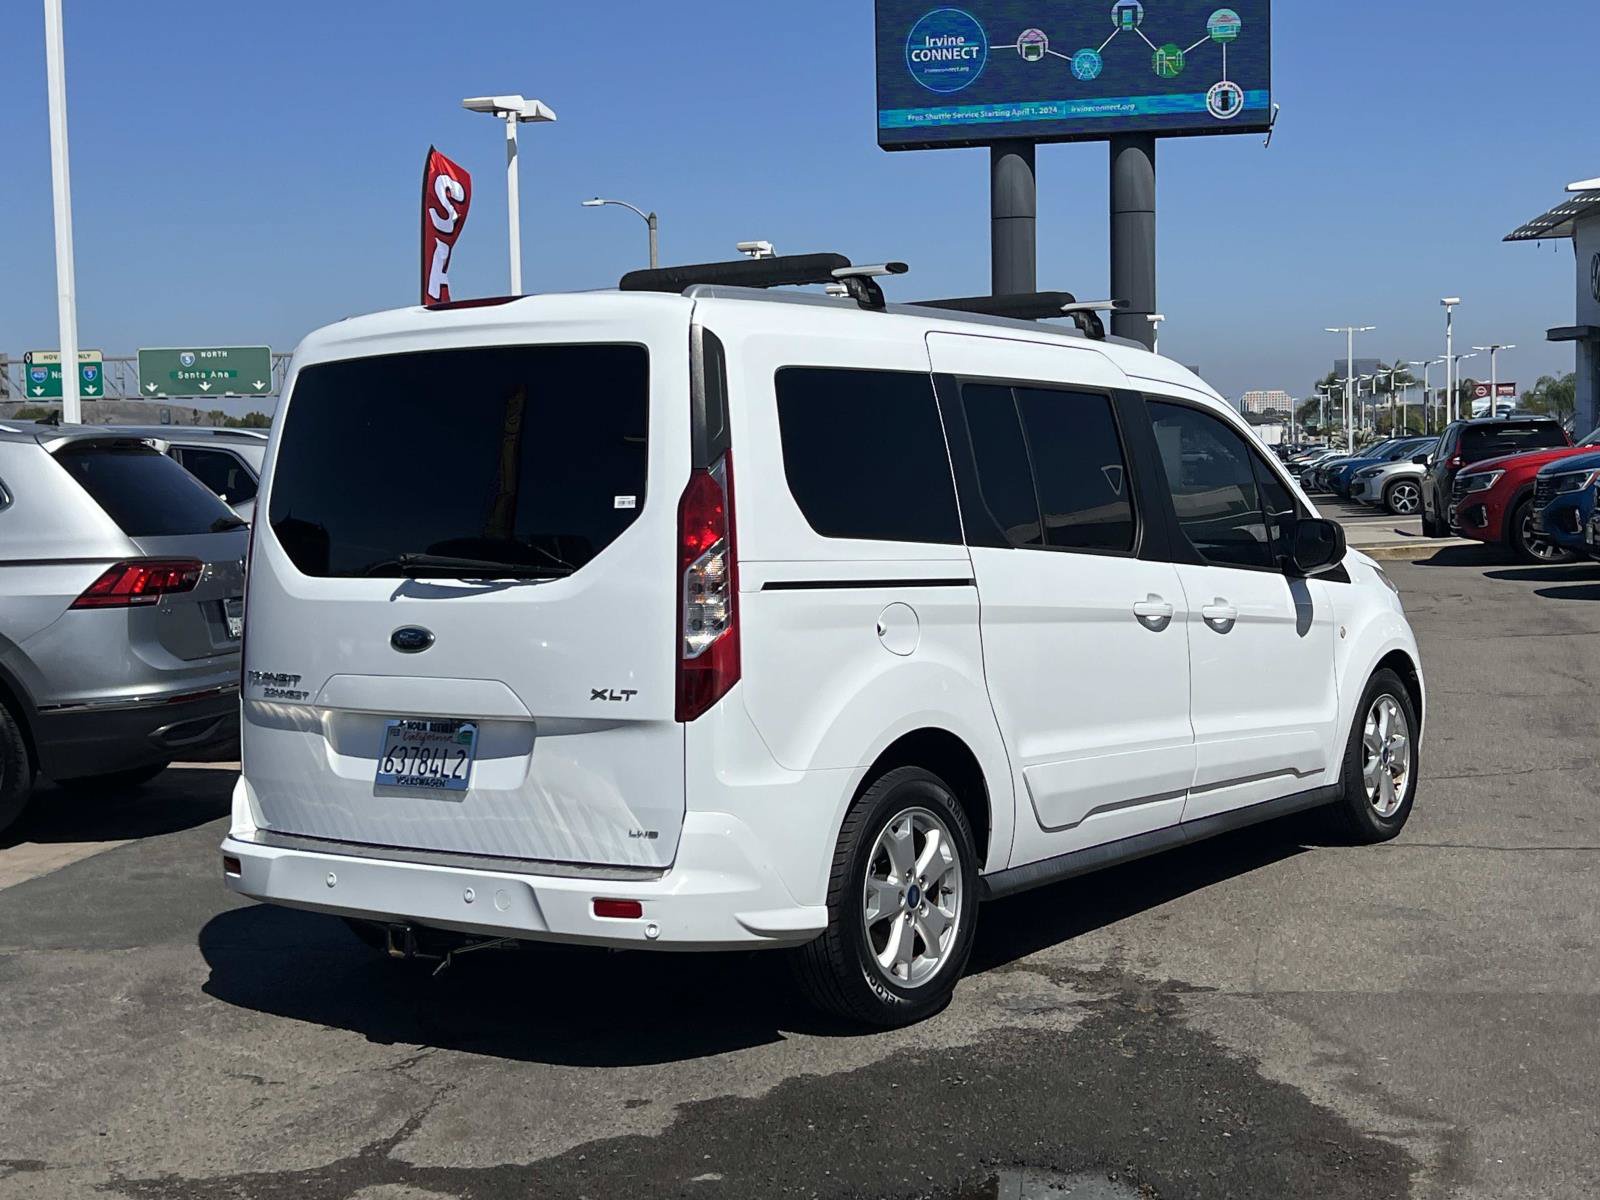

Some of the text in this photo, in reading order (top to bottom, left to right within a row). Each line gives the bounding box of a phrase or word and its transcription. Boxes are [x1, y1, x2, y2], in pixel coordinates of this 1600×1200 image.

[925, 34, 965, 47] Irvine
[911, 46, 979, 62] CONNECT
[925, 112, 951, 120] Shuttle
[952, 111, 979, 119] Service
[980, 108, 1010, 118] Starting
[1011, 107, 1029, 117] April
[1039, 106, 1058, 114] 2024
[177, 370, 230, 379] Santa Ana
[590, 688, 638, 701] XLT
[384, 744, 467, 779] 63784L2
